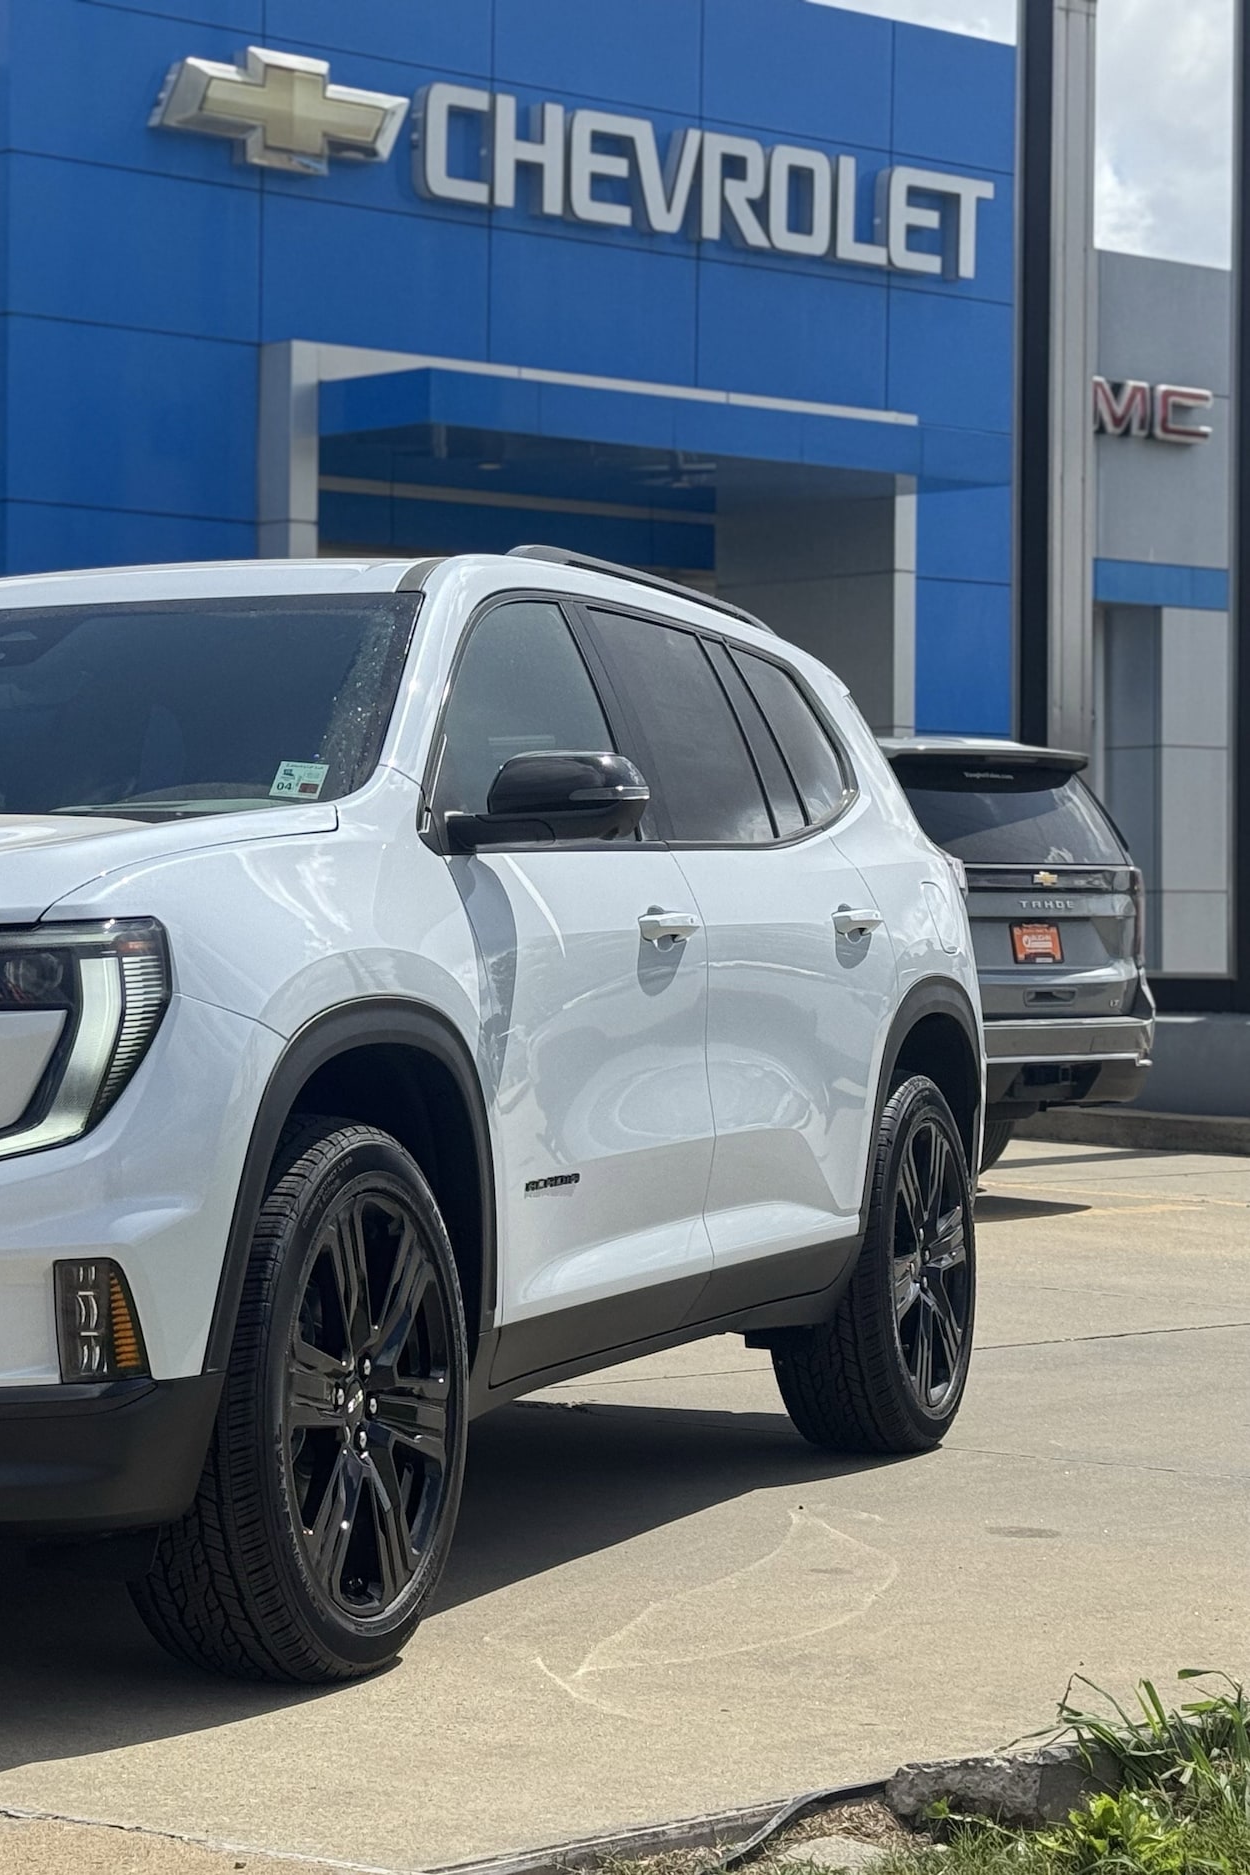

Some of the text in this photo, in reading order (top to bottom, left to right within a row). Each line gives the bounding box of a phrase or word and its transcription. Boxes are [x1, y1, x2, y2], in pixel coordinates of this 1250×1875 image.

[414, 82, 995, 280] CHEVROLET
[1092, 375, 1214, 445] MC
[276, 781, 292, 791] 04
[1019, 900, 1075, 909] TAHOE
[525, 1172, 580, 1192] ACADIA
